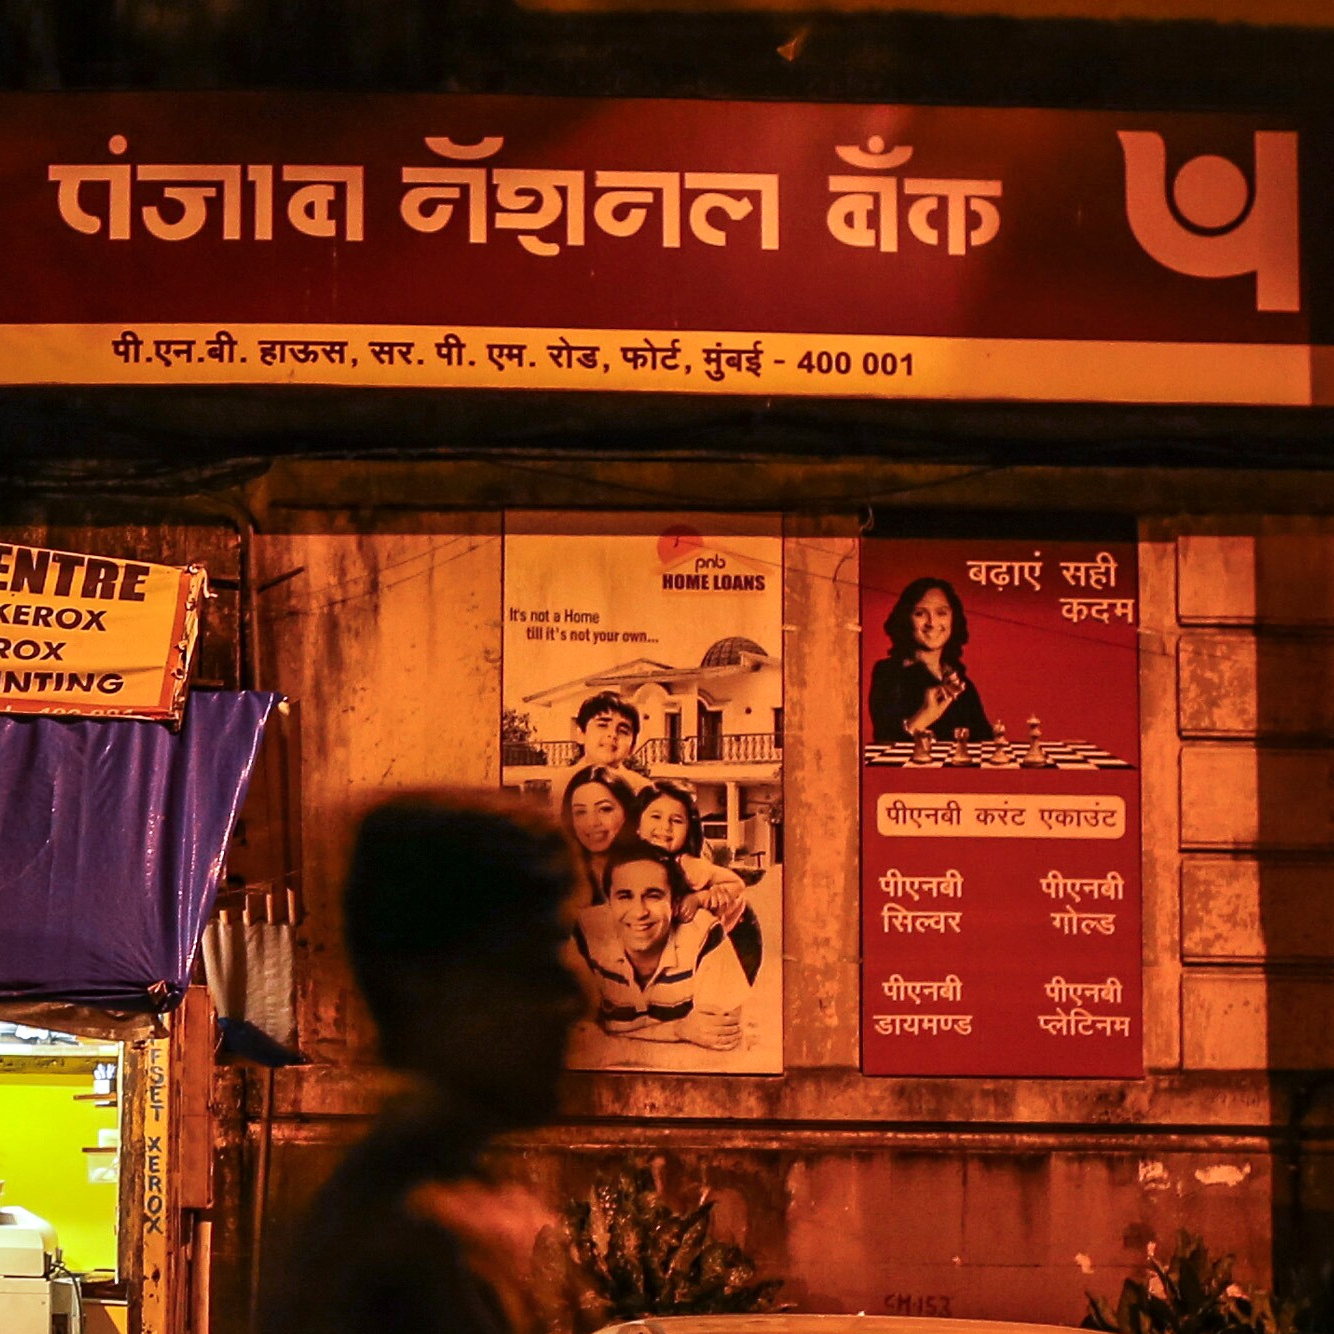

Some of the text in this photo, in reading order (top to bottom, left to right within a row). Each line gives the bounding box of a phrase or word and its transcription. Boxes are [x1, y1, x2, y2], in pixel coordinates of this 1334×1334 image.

[48, 133, 364, 242] पंजाब
[400, 136, 779, 256] नॅशनल
[258, 339, 357, 367] हाऊस,
[368, 341, 424, 366] सर.
[435, 333, 475, 366] पी.
[487, 342, 536, 371] एम.
[547, 336, 610, 373] रोड,
[621, 338, 692, 374] फोर्ट,
[702, 340, 763, 381] मुंबई
[797, 350, 852, 376] 400
[862, 352, 914, 376] 001
[695, 554, 726, 572] pnb
[966, 550, 1118, 591] बढ़ाएं सही
[663, 574, 766, 591] HOME LOANS
[509, 607, 600, 624] It's not a Home
[1059, 598, 1135, 624] कदम
[526, 626, 543, 640] till
[570, 628, 590, 642] not
[593, 632, 620, 645] your
[885, 800, 1117, 829] पीएनबी करंट एकाउंट
[878, 868, 964, 901] पीएनबी
[1039, 870, 1125, 903] पीएनबी
[881, 902, 963, 933] सिल्वर
[1050, 904, 1116, 935] गोल्ड
[882, 973, 963, 1005] पीएनबी
[1044, 975, 1123, 1007] पीएनबी
[873, 1014, 973, 1036] डायमण्ड
[1037, 1007, 1131, 1037] प्लेटिनम
[146, 1137, 164, 1235] XEROX
